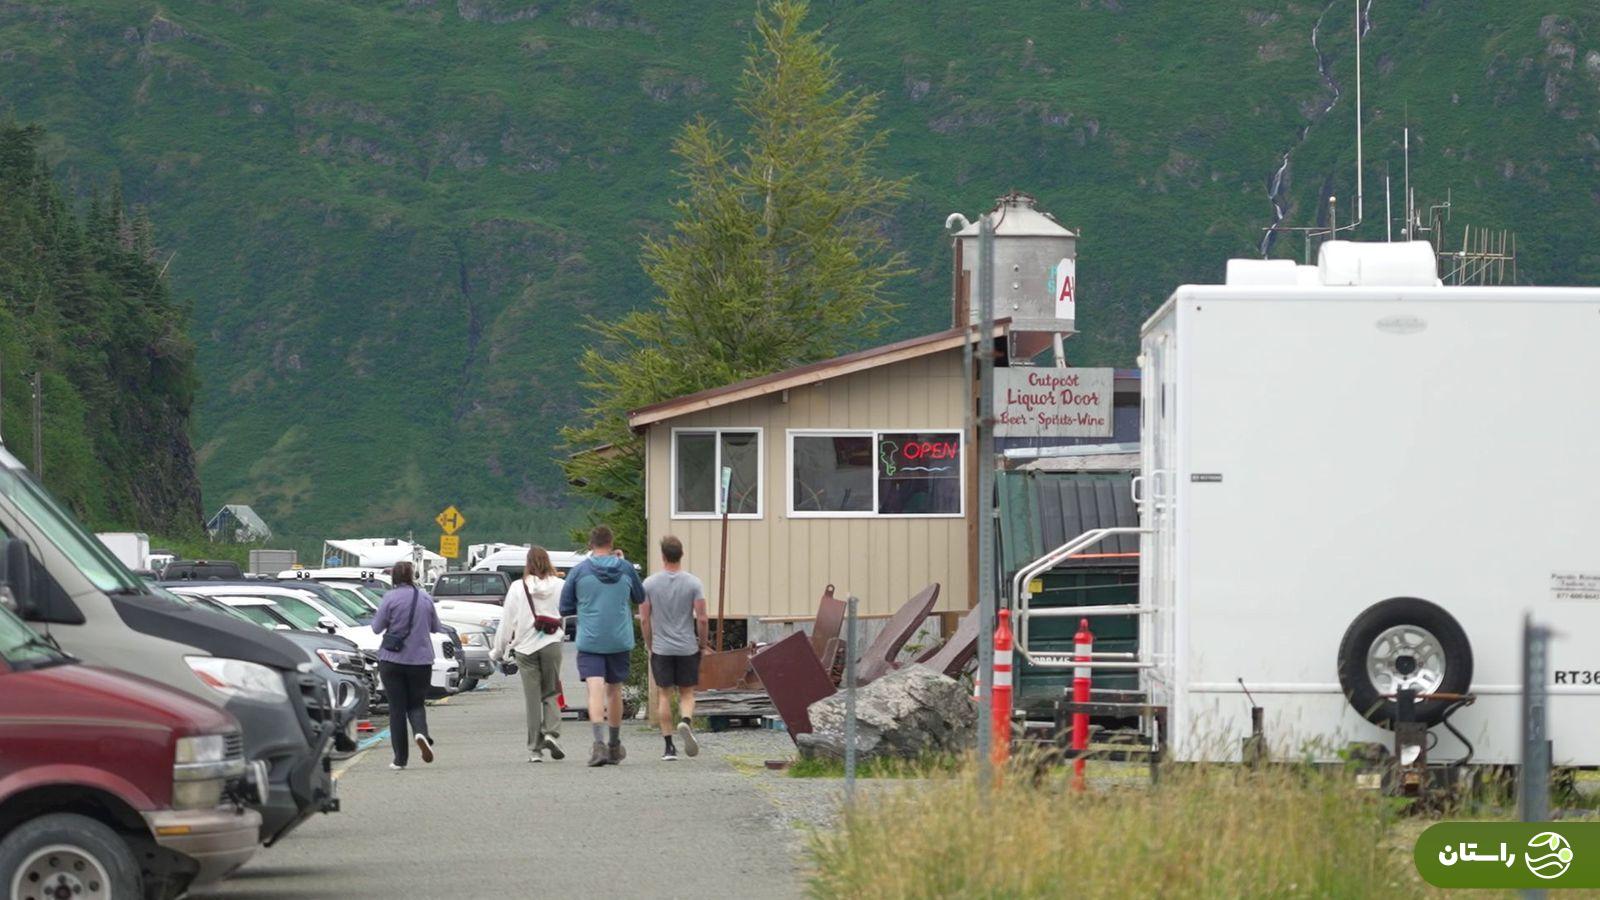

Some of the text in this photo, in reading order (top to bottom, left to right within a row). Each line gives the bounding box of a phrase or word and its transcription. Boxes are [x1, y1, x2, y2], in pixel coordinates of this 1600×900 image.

[1028, 372, 1080, 391] Outpost
[1007, 388, 1099, 412] Liquor Door
[1000, 411, 1028, 424] Beer
[902, 441, 958, 460] OPEN
[1554, 670, 1600, 685] RT36
